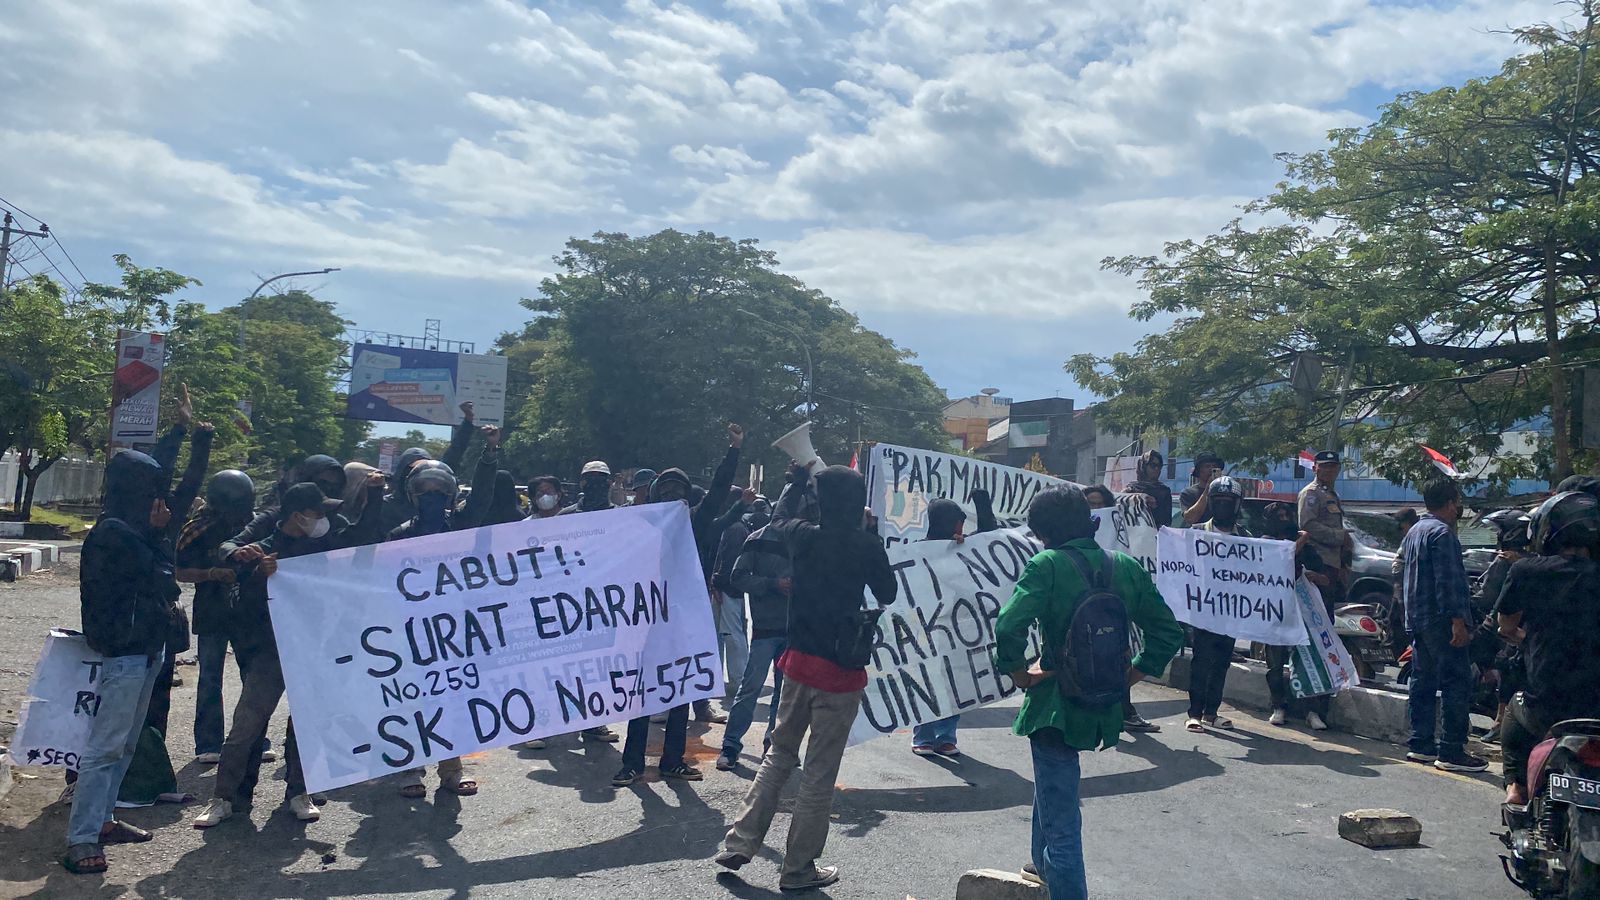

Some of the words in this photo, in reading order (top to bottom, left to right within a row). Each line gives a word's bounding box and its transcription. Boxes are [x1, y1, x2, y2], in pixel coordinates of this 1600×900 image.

[120, 415, 153, 424] MERAH
[950, 460, 998, 504] MAU
[999, 471, 1050, 514] NYA
[956, 532, 1041, 590] NON
[1160, 560, 1200, 577] NOPOL
[1212, 567, 1295, 590] KENDARAAN
[1195, 539, 1263, 562] DICARI!
[530, 580, 669, 640] EDARAN
[82, 660, 103, 684] T
[380, 663, 480, 707] No.259
[556, 651, 715, 724] No.574-575
[861, 662, 941, 733] UIN
[942, 643, 1017, 708] LEB
[468, 688, 535, 744] DO
[1552, 776, 1569, 788] DD
